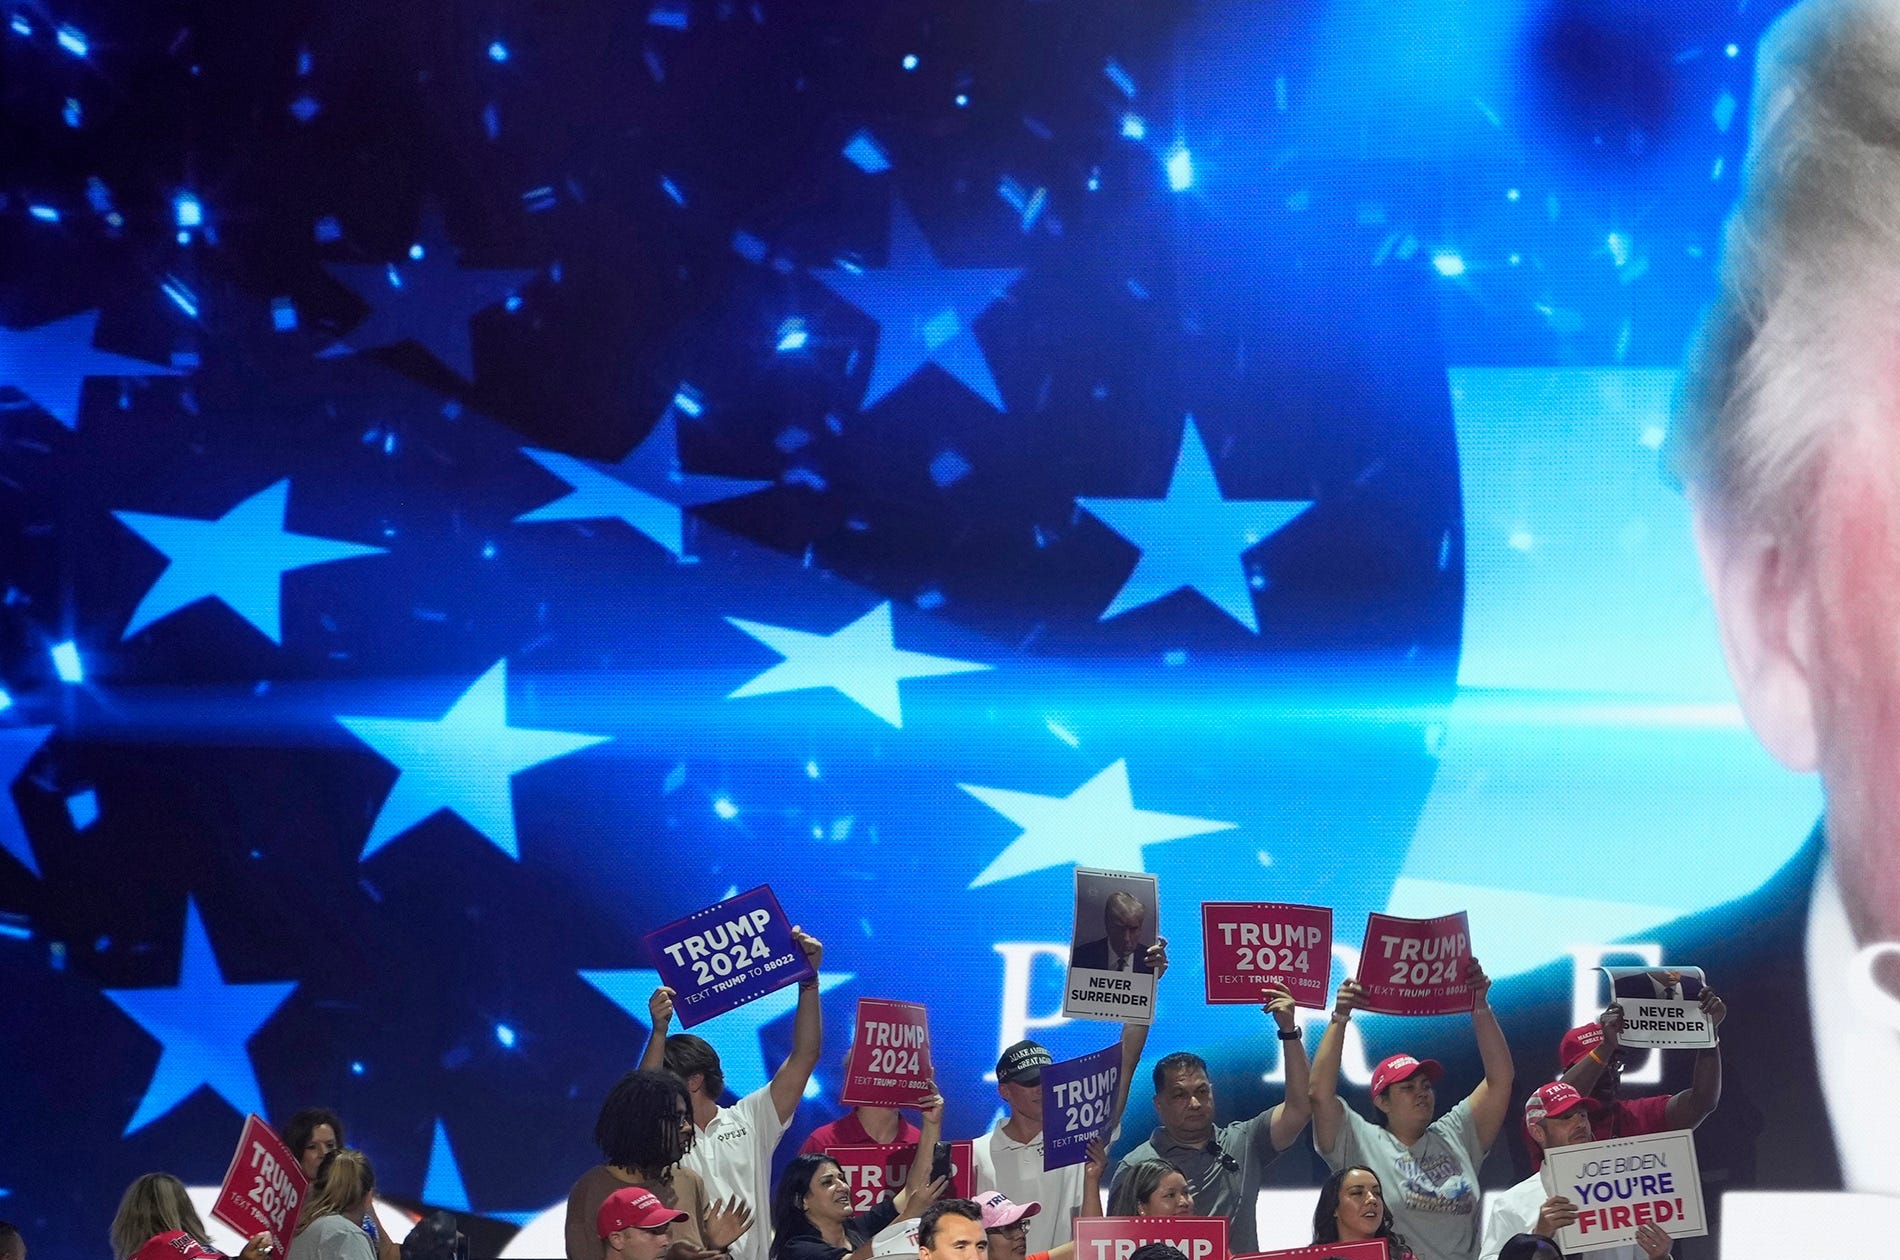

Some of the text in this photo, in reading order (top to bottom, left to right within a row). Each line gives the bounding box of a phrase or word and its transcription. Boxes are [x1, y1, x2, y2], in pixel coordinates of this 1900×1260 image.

[664, 909, 770, 967] TRUMP
[1218, 923, 1321, 949] TRUMP
[1380, 934, 1466, 961] TRUMP
[692, 936, 771, 986] 2024
[1236, 947, 1309, 973] 2024
[1389, 960, 1458, 985] 2024
[685, 953, 796, 1005] TEXT TRUMP TO 88022
[1089, 977, 1131, 991] NEVER
[1218, 975, 1245, 985] TEXT
[1248, 975, 1284, 984] TRUMP
[1286, 976, 1297, 985] TO
[1368, 984, 1395, 996] TEXT
[1398, 988, 1431, 998] TRUMP
[1071, 989, 1148, 1006] SURRENDER
[1640, 1006, 1684, 1019] NEVER
[865, 1021, 925, 1049] TRUMP
[1623, 1020, 1705, 1032] SURRENDER
[868, 1049, 920, 1075] 2024
[854, 1075, 872, 1085] TEXT
[872, 1077, 898, 1088] TRUMP
[898, 1079, 908, 1088] TO
[1053, 1067, 1118, 1108] TRUMP
[1065, 1095, 1111, 1132] 2024
[1052, 1129, 1099, 1148] TEXT TRUMP
[251, 1140, 298, 1212] TRUMP
[1576, 1160, 1610, 1179] JOE
[231, 1191, 251, 1212] TEXT
[1574, 1172, 1675, 1205] YOU'RE
[248, 1176, 286, 1232] 2024
[1577, 1198, 1684, 1234] FIRED!
